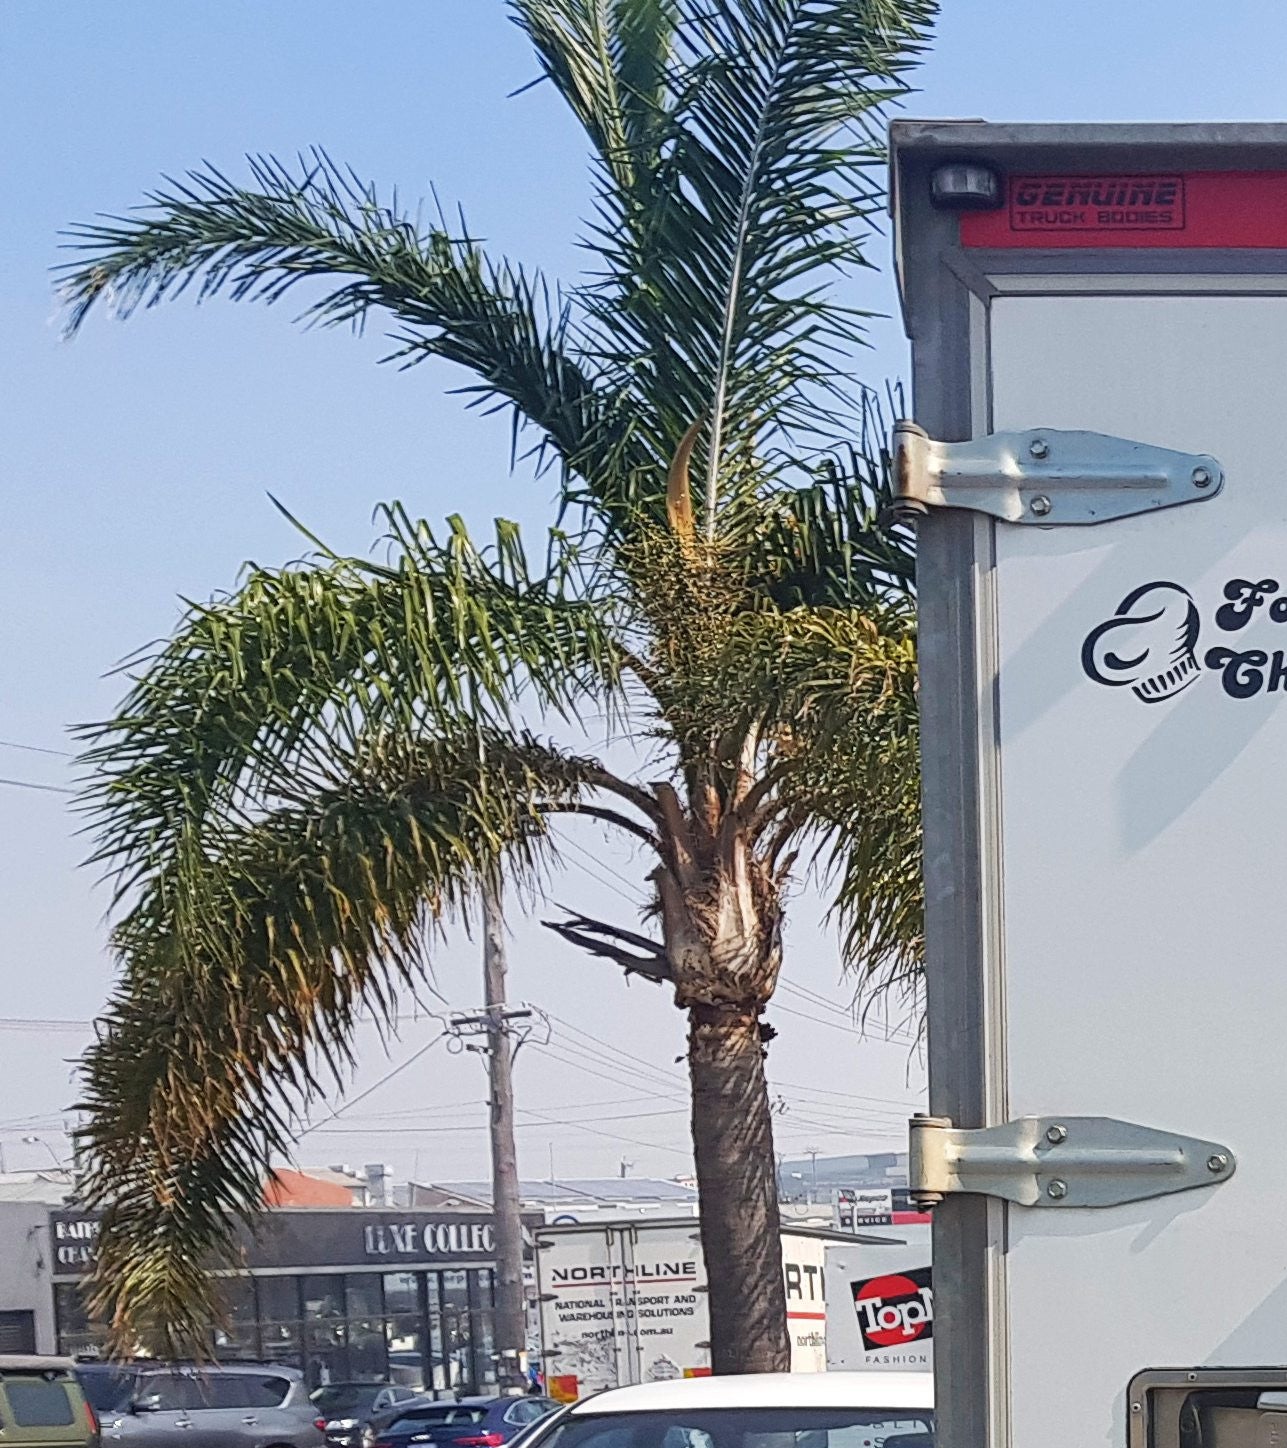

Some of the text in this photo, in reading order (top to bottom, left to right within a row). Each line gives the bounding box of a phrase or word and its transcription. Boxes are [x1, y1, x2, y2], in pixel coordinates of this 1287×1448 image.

[1016, 182, 1177, 206] GENUINE
[1017, 211, 1173, 224] TRUCK BODIES
[364, 1224, 417, 1254] LUXE
[552, 1261, 697, 1282] NORTHLINE
[554, 1299, 605, 1311] NATIONAL
[673, 1294, 697, 1304] AND
[558, 1307, 695, 1323] WAREHOUSING SOLUTIONS
[865, 1354, 927, 1364] FASHION
